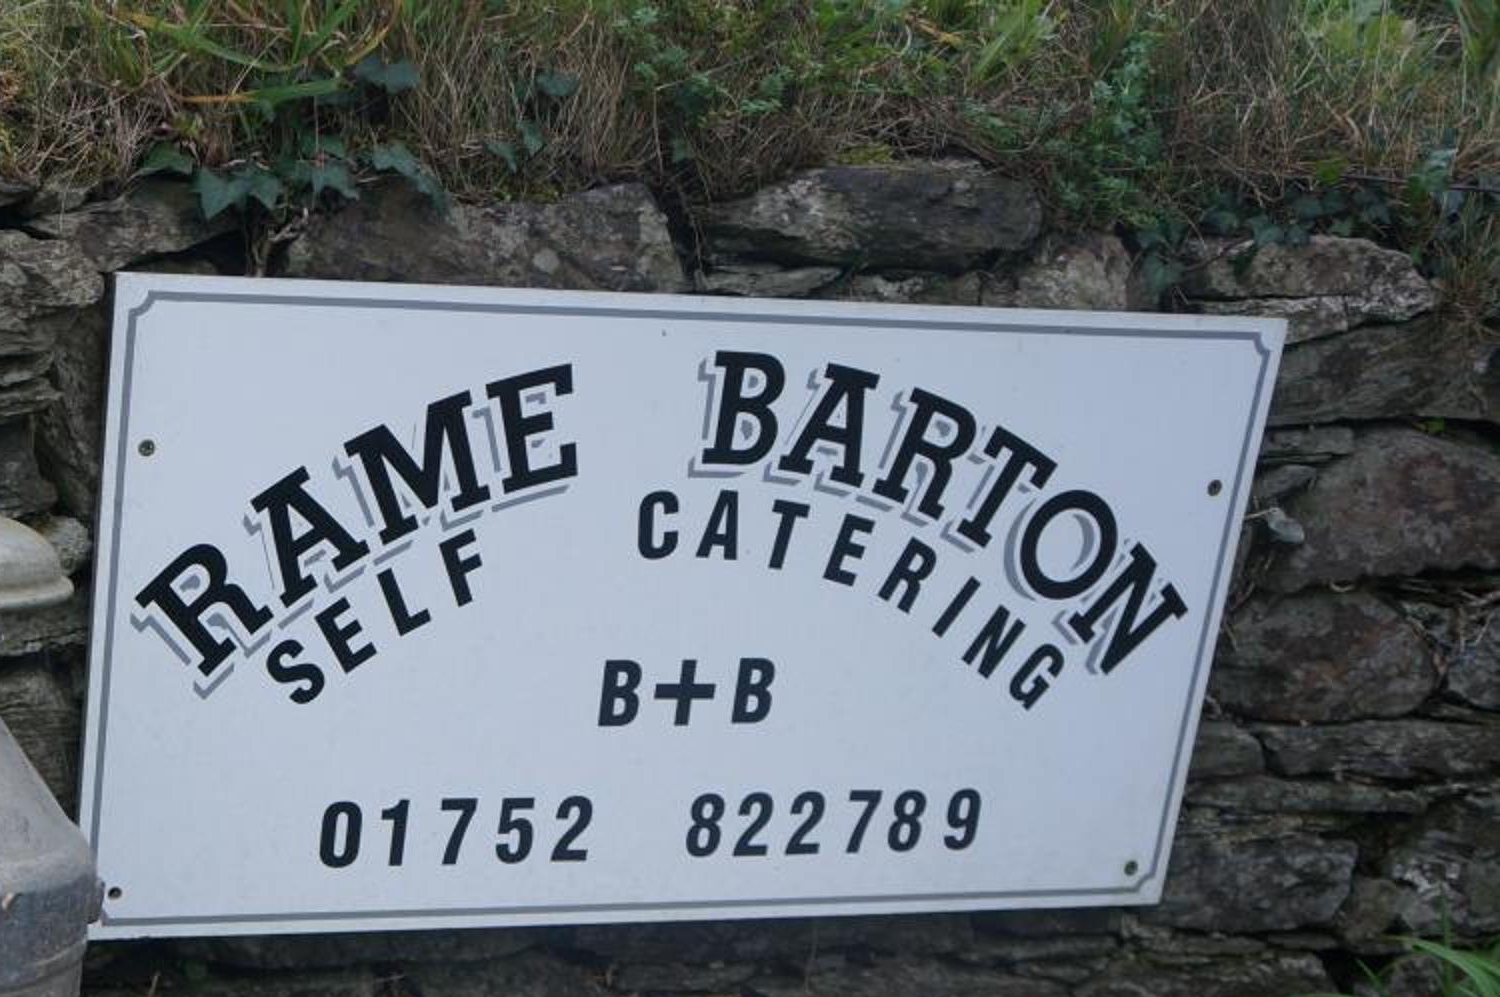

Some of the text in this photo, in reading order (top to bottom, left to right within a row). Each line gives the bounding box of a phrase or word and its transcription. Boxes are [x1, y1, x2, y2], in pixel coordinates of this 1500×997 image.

[133, 351, 1189, 680] RAME BARTON
[267, 490, 1065, 711] SELF CATERING
[599, 658, 775, 727] B+B
[319, 788, 981, 869] 01752 822789
